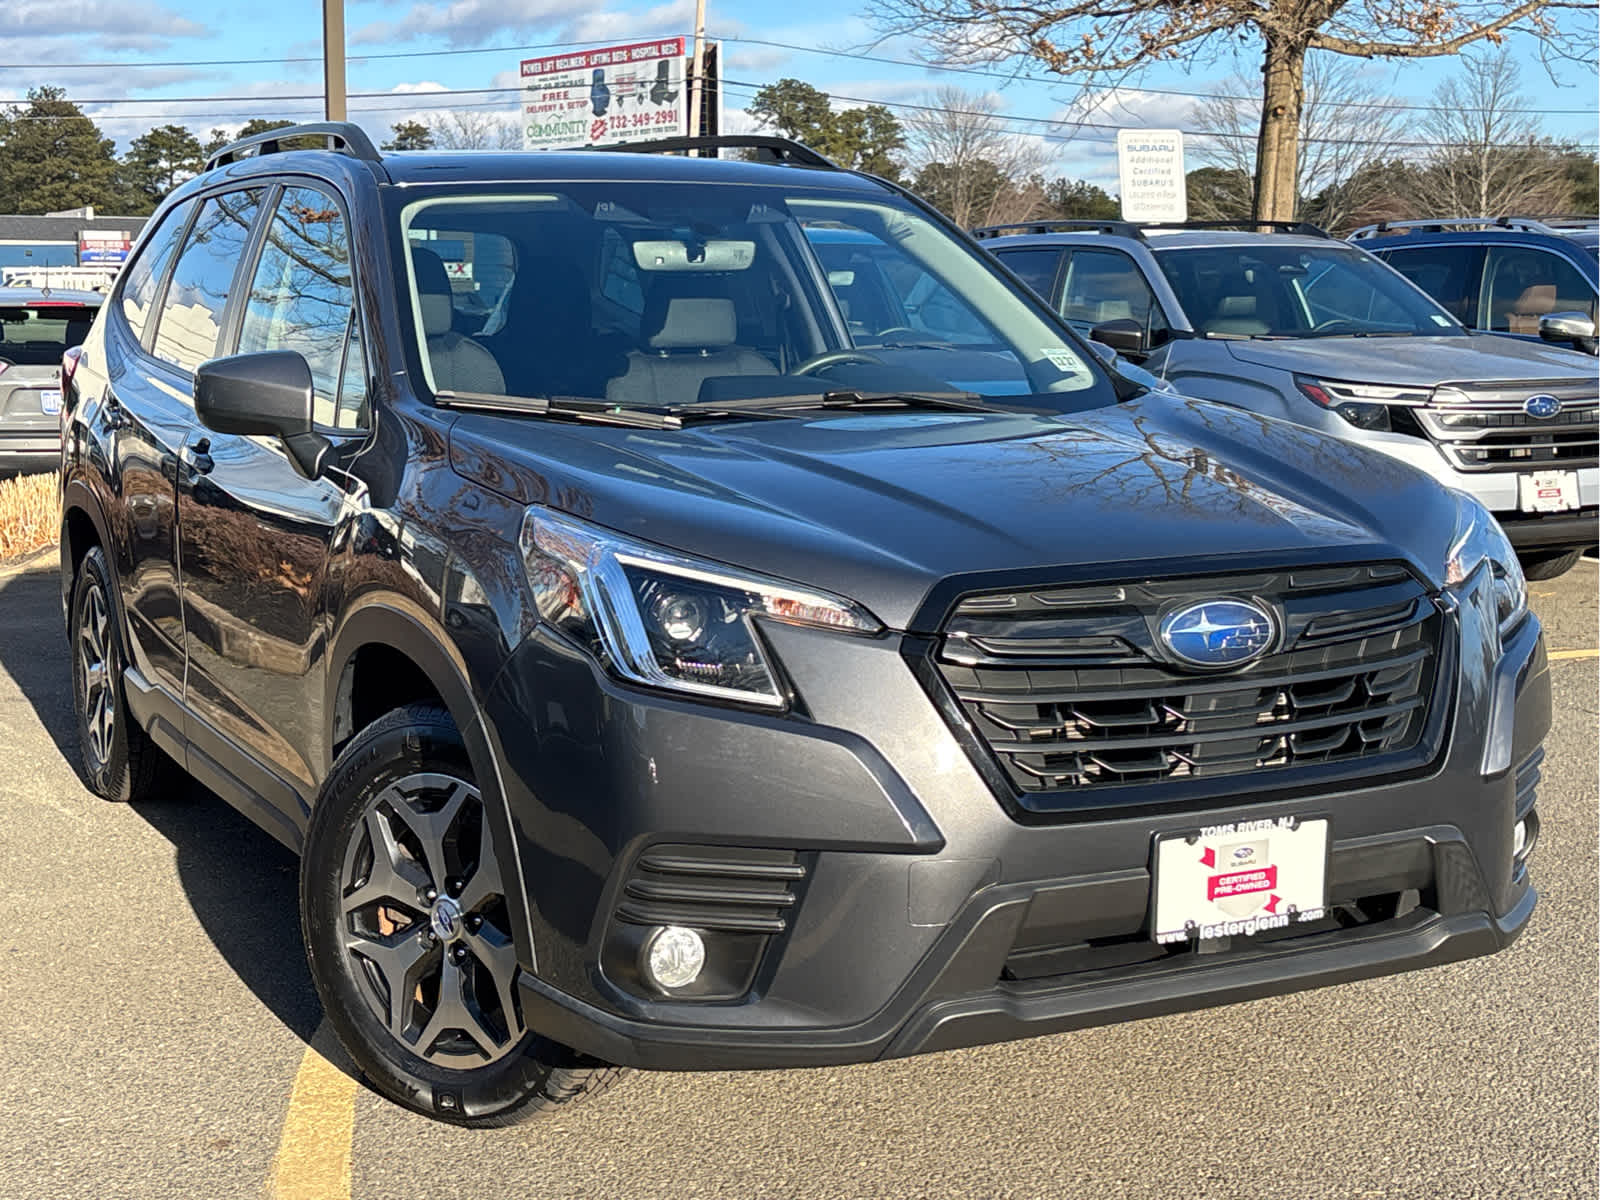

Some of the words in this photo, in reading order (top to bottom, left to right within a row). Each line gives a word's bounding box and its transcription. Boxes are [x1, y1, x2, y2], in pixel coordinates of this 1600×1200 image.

[542, 90, 569, 102] FREE
[526, 103, 556, 113] DELIVERY
[567, 100, 589, 109] SETUP
[609, 109, 678, 129] 732-349-2991
[526, 120, 588, 138] COMMUNITY
[1127, 144, 1175, 152] SUBARU
[1132, 167, 1172, 175] Certified
[1200, 823, 1236, 837] TOMS
[1278, 815, 1295, 828] NJ
[1218, 871, 1266, 886] CERTIFIED
[1214, 879, 1270, 896] PRE-OWNED
[1199, 914, 1289, 938] lesterglenn
